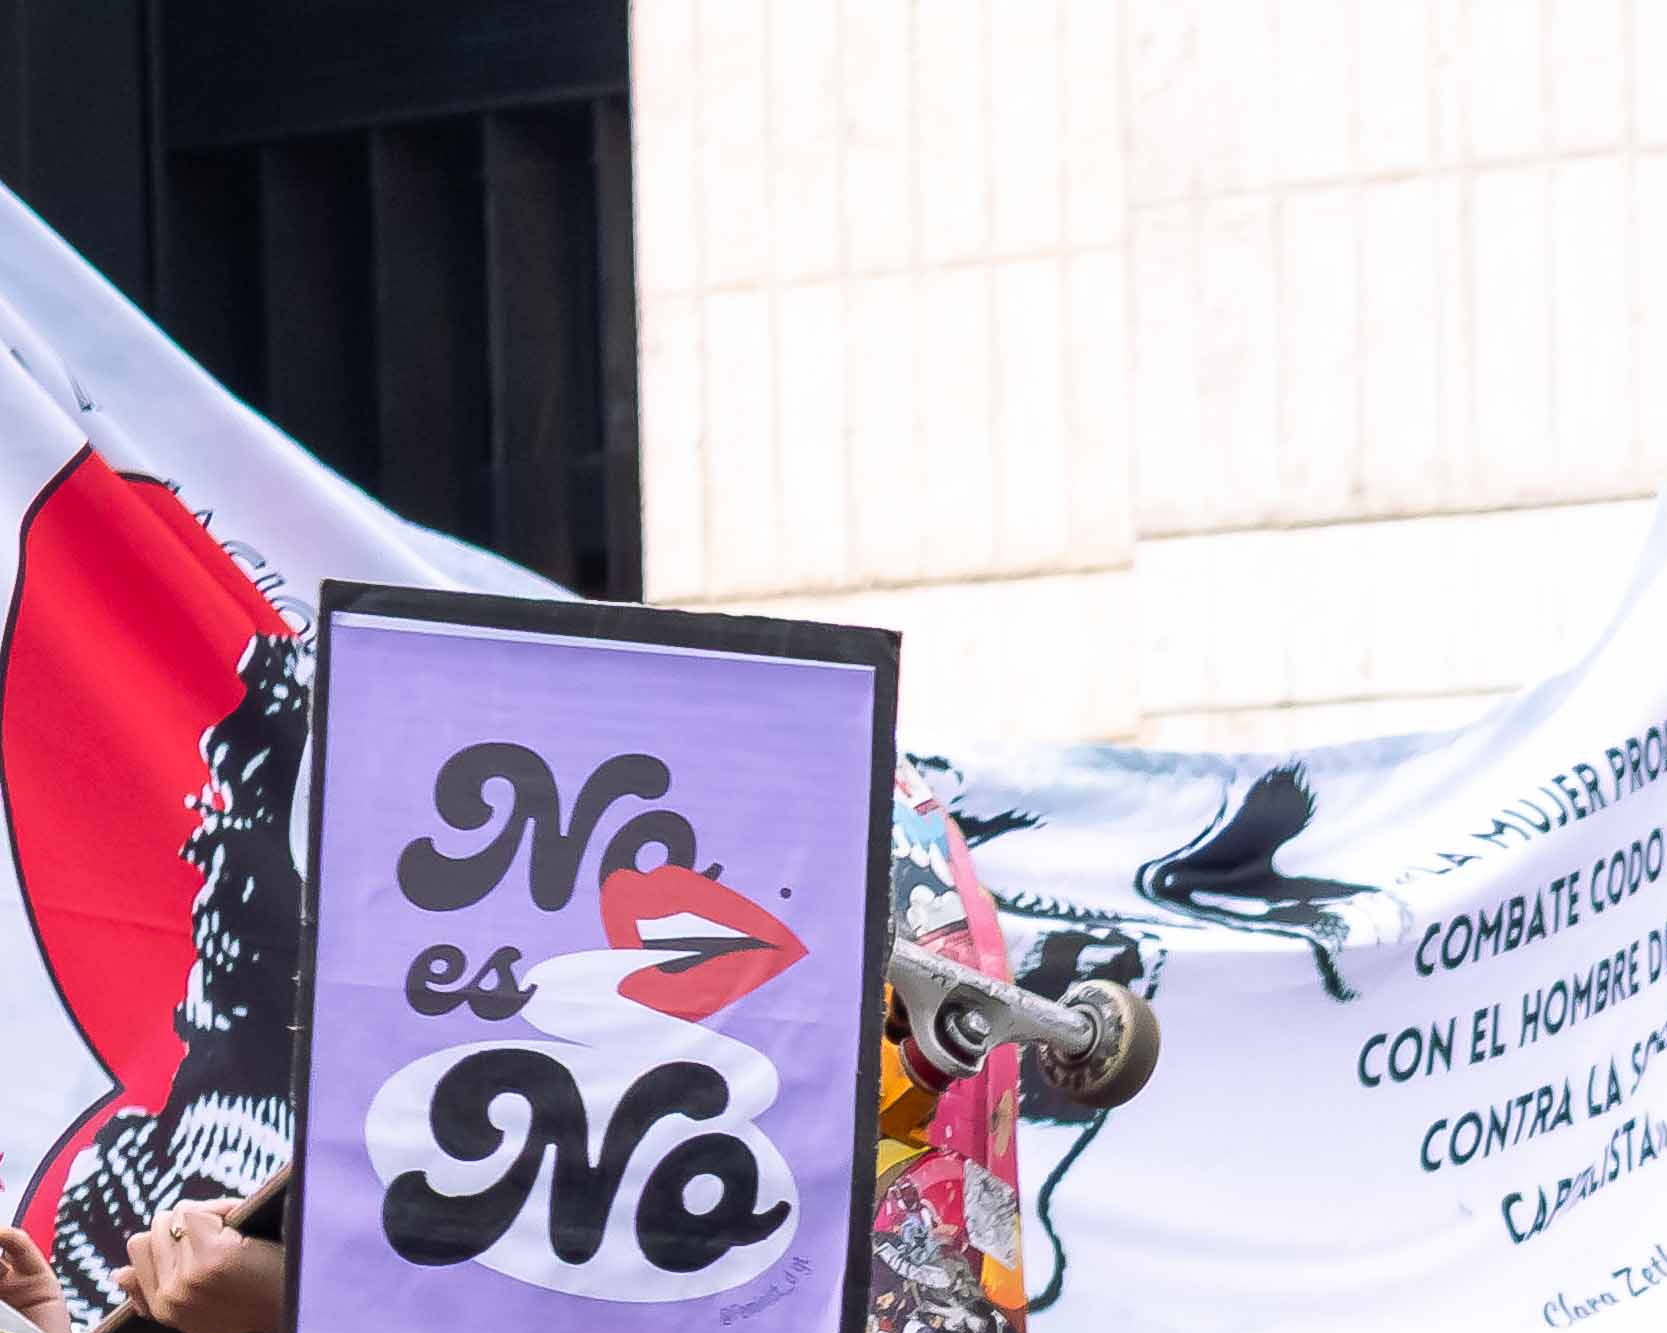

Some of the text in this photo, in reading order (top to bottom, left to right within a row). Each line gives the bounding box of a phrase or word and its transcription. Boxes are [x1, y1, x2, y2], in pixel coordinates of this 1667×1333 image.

[397, 741, 723, 912] No
[1469, 762, 1607, 850] MUJER
[1416, 871, 1581, 977] COMBATE
[1590, 827, 1664, 914] CODO
[406, 944, 537, 1020] es
[1357, 1015, 1457, 1088] CON
[1469, 1003, 1506, 1065] EL
[1519, 939, 1640, 1049] HOMBRE
[382, 1048, 791, 1272] No
[1421, 1076, 1573, 1172] CONTRA
[1587, 1055, 1622, 1118] LA
[1543, 1292, 1620, 1330] Clara
